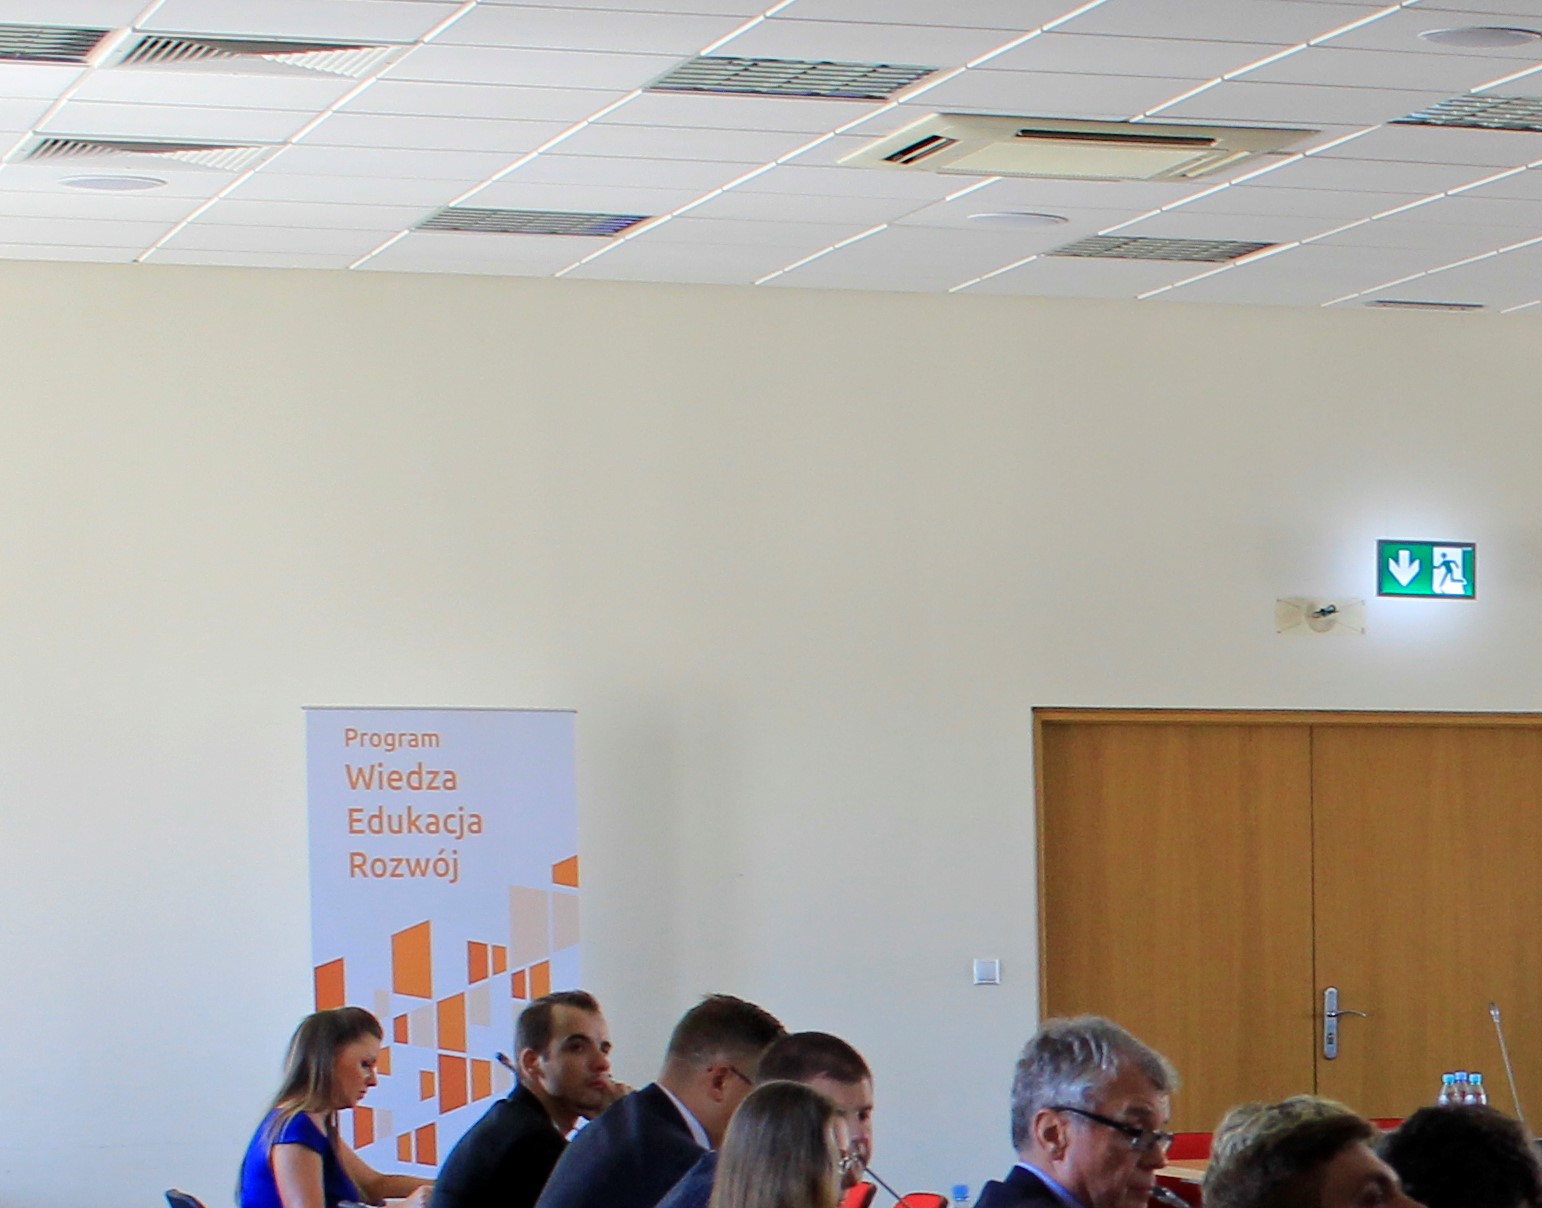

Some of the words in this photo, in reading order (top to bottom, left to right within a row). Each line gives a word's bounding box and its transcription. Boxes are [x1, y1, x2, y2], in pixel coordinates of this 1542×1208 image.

[344, 727, 441, 752] Program
[345, 761, 458, 791] Wiedza
[348, 805, 483, 840] Edukacja
[349, 848, 459, 884] Rozwój
